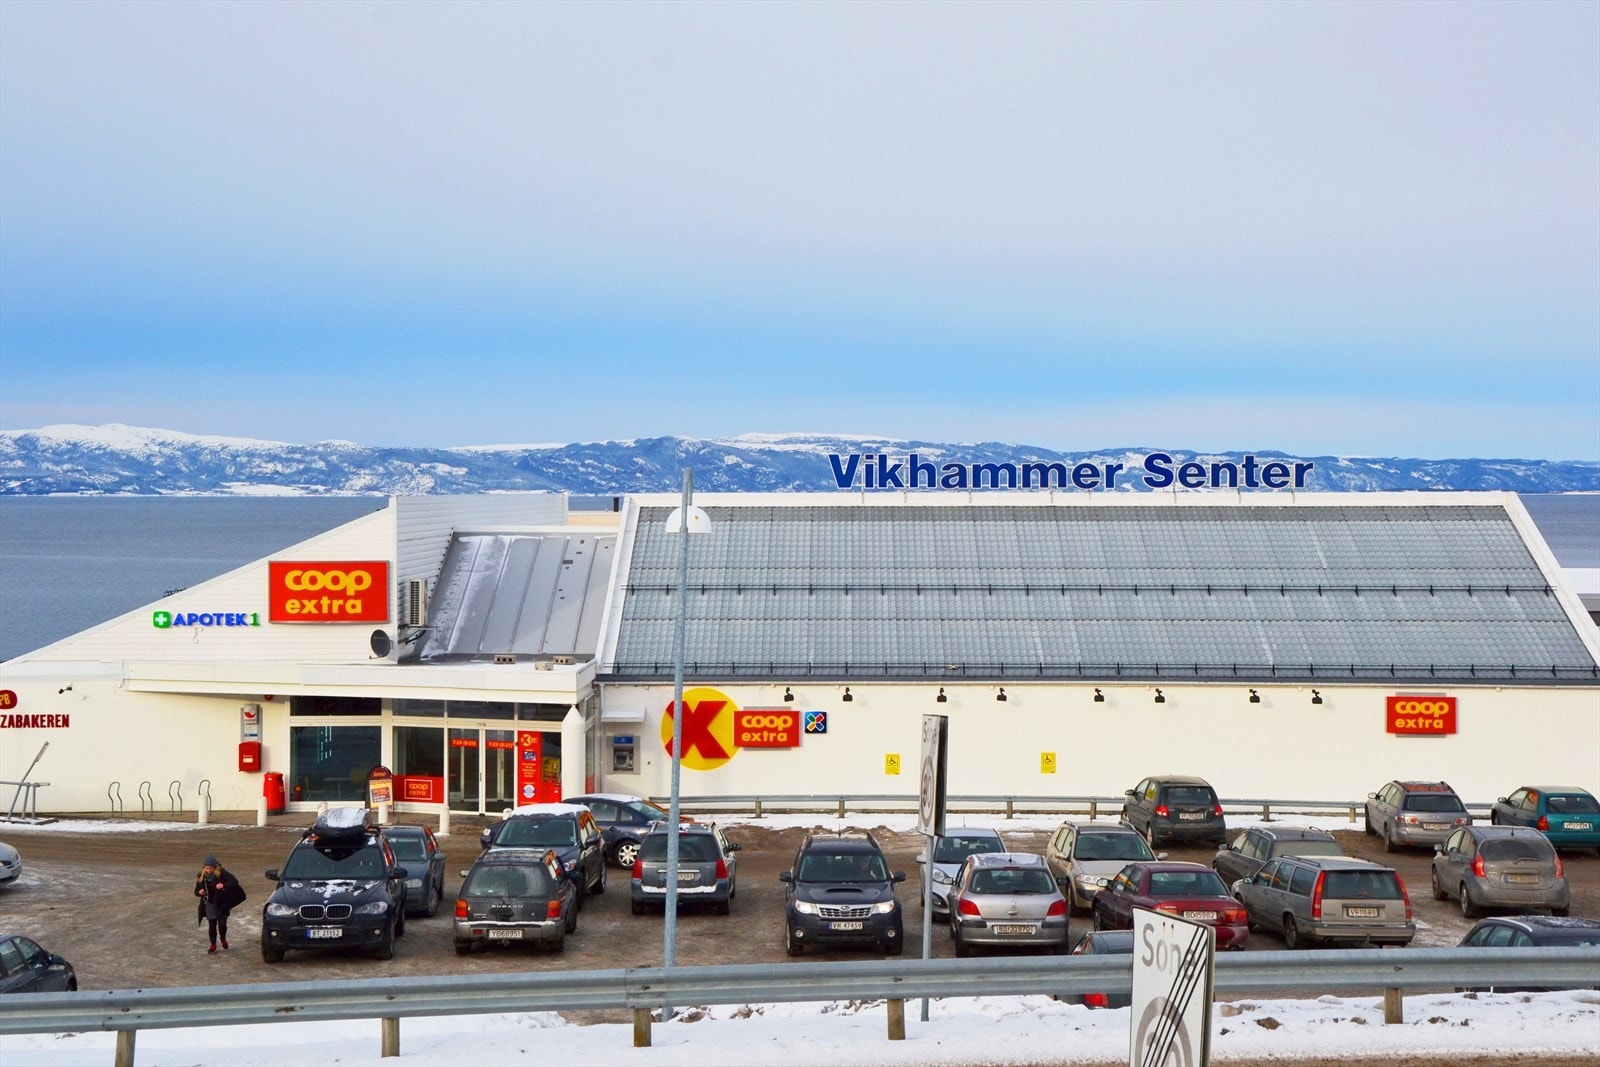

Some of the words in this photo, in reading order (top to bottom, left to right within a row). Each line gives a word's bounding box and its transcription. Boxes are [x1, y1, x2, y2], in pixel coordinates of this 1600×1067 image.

[828, 453, 1124, 489] Vikhammer
[1143, 453, 1314, 489] Senter
[285, 570, 372, 595] coop
[285, 596, 362, 614] extra
[1395, 701, 1449, 718] coop
[0, 714, 70, 729] ZABAKEREN
[741, 715, 793, 731] coop
[1395, 717, 1444, 729] extra
[741, 731, 788, 742] extra
[409, 783, 429, 791] coop
